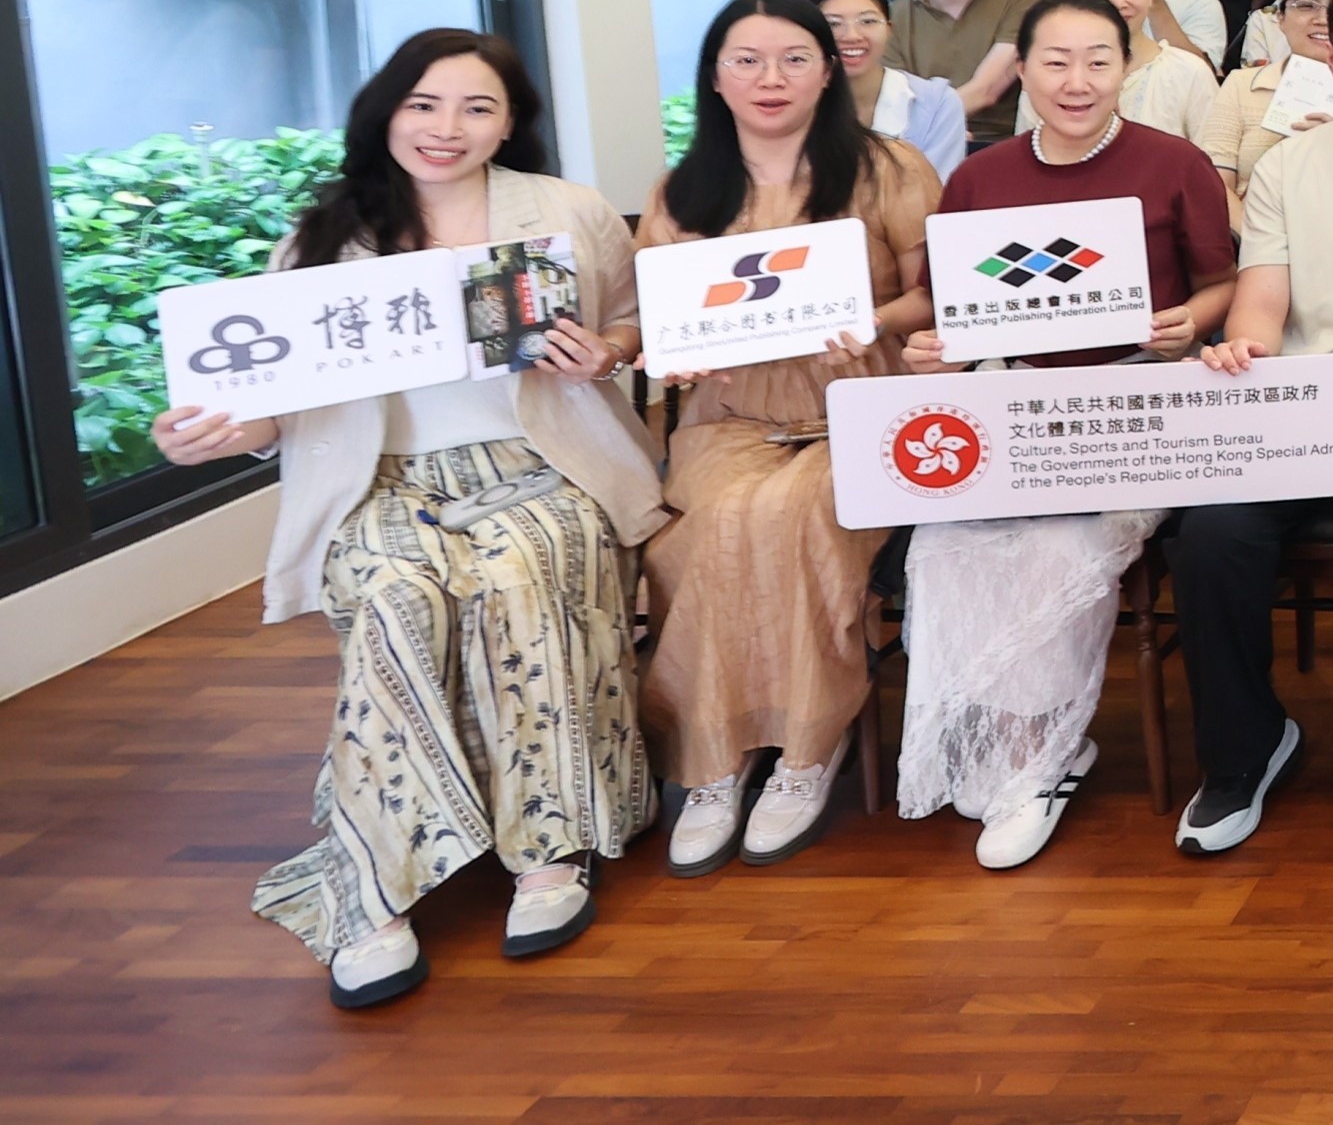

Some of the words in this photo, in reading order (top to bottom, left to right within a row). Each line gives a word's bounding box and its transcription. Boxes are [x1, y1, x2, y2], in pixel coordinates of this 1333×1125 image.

[312, 287, 438, 350] 博雅
[942, 320, 969, 329] Hong
[971, 316, 998, 326] Kong
[1000, 311, 1053, 323] Publishing
[1055, 305, 1107, 318] Federation
[1109, 301, 1145, 312] Limited
[315, 354, 375, 373] POK
[390, 340, 446, 359] ART
[1007, 384, 1319, 416] 中華人民共和國香港特別行政區政府
[1008, 416, 1165, 440] 文化體育及旅遊局
[1009, 444, 1066, 458] Culture,
[1069, 442, 1118, 456] Sports
[1122, 439, 1149, 451] and
[1153, 436, 1209, 450] Tourism
[1213, 434, 1263, 446] Bureau
[1010, 461, 1037, 473] The
[1041, 456, 1128, 471] Government
[1132, 455, 1146, 467] of
[1149, 454, 1172, 466] the
[1175, 453, 1213, 466] Hong
[1217, 449, 1253, 462] Kong
[1256, 445, 1306, 461] Special
[908, 483, 939, 495] HONG
[943, 479, 973, 495] KONG
[1011, 477, 1026, 489] of
[1029, 476, 1052, 488] the
[1056, 472, 1117, 486] People's
[1121, 469, 1182, 484] Republic
[1185, 468, 1199, 480] of
[1203, 465, 1243, 478] China
